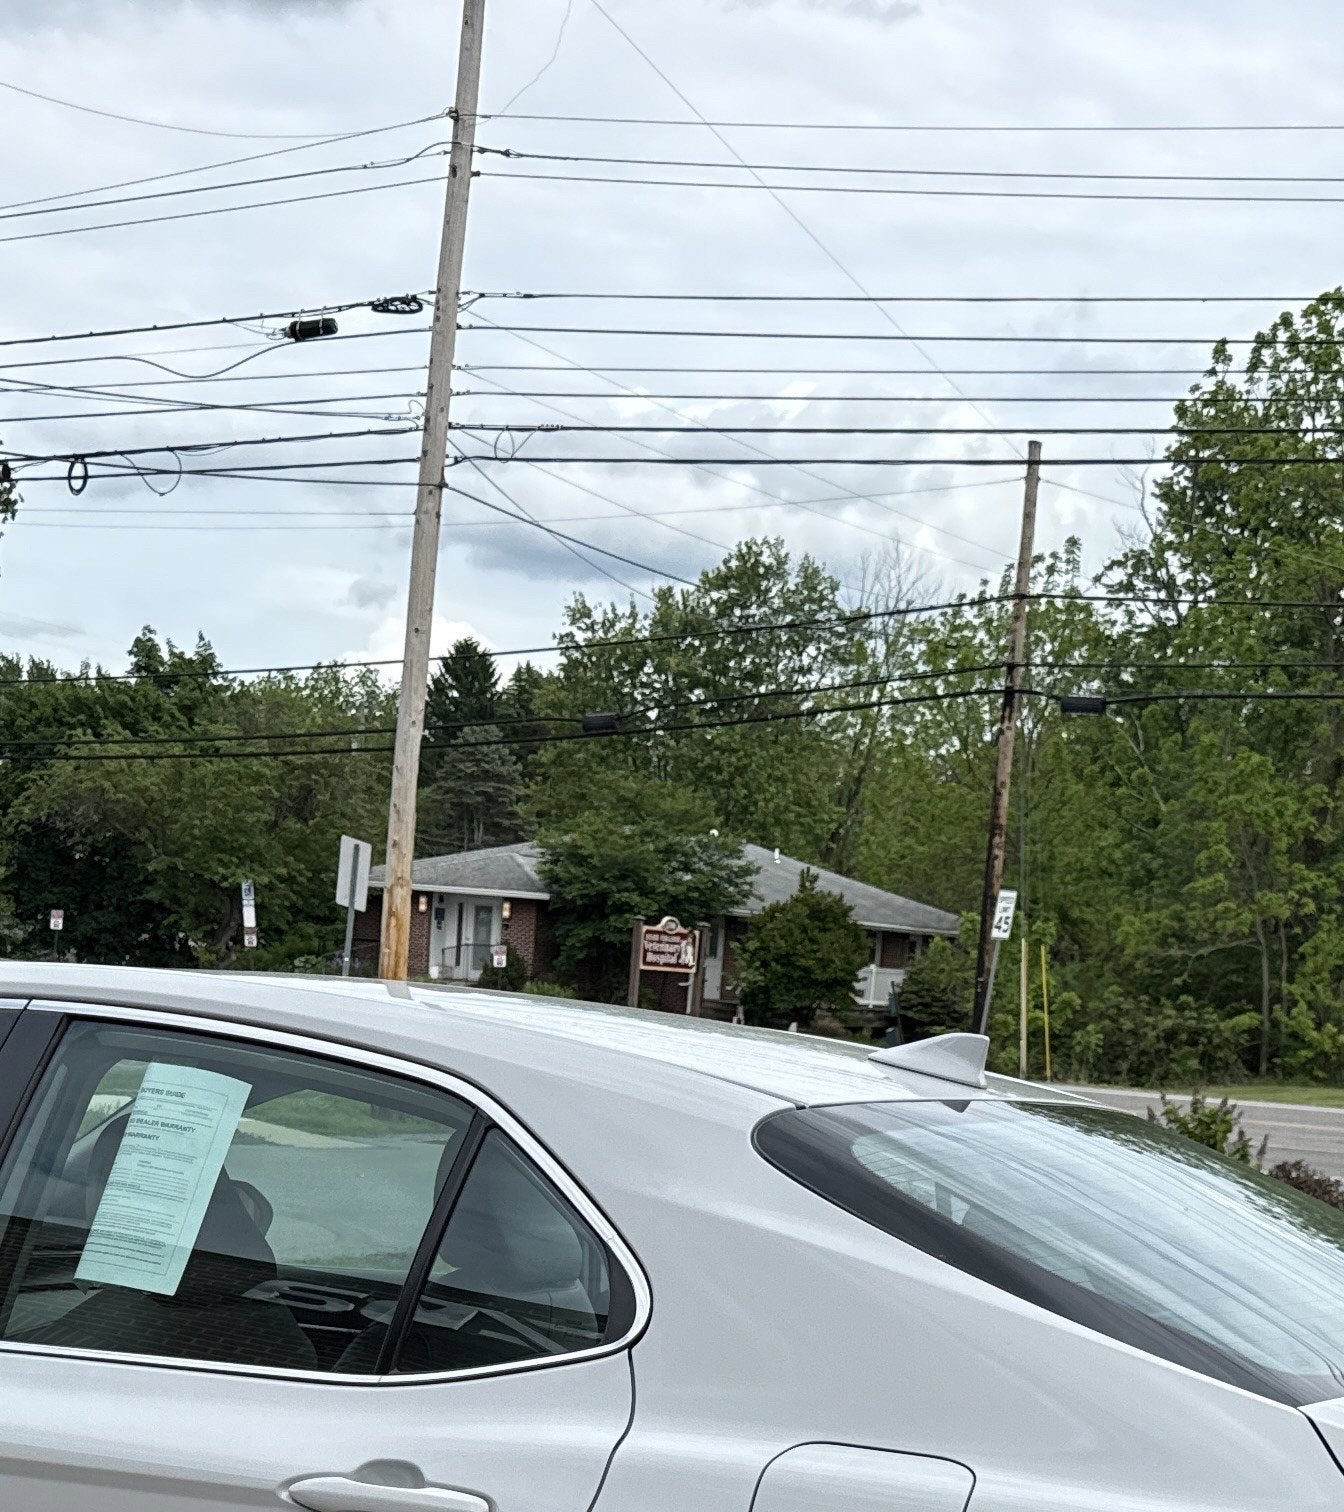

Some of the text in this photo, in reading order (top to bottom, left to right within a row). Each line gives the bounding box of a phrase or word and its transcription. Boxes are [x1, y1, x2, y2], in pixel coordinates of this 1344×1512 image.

[994, 915, 1011, 934] 45
[136, 1117, 160, 1127] DEALER
[160, 1122, 197, 1133] WARRANTY
